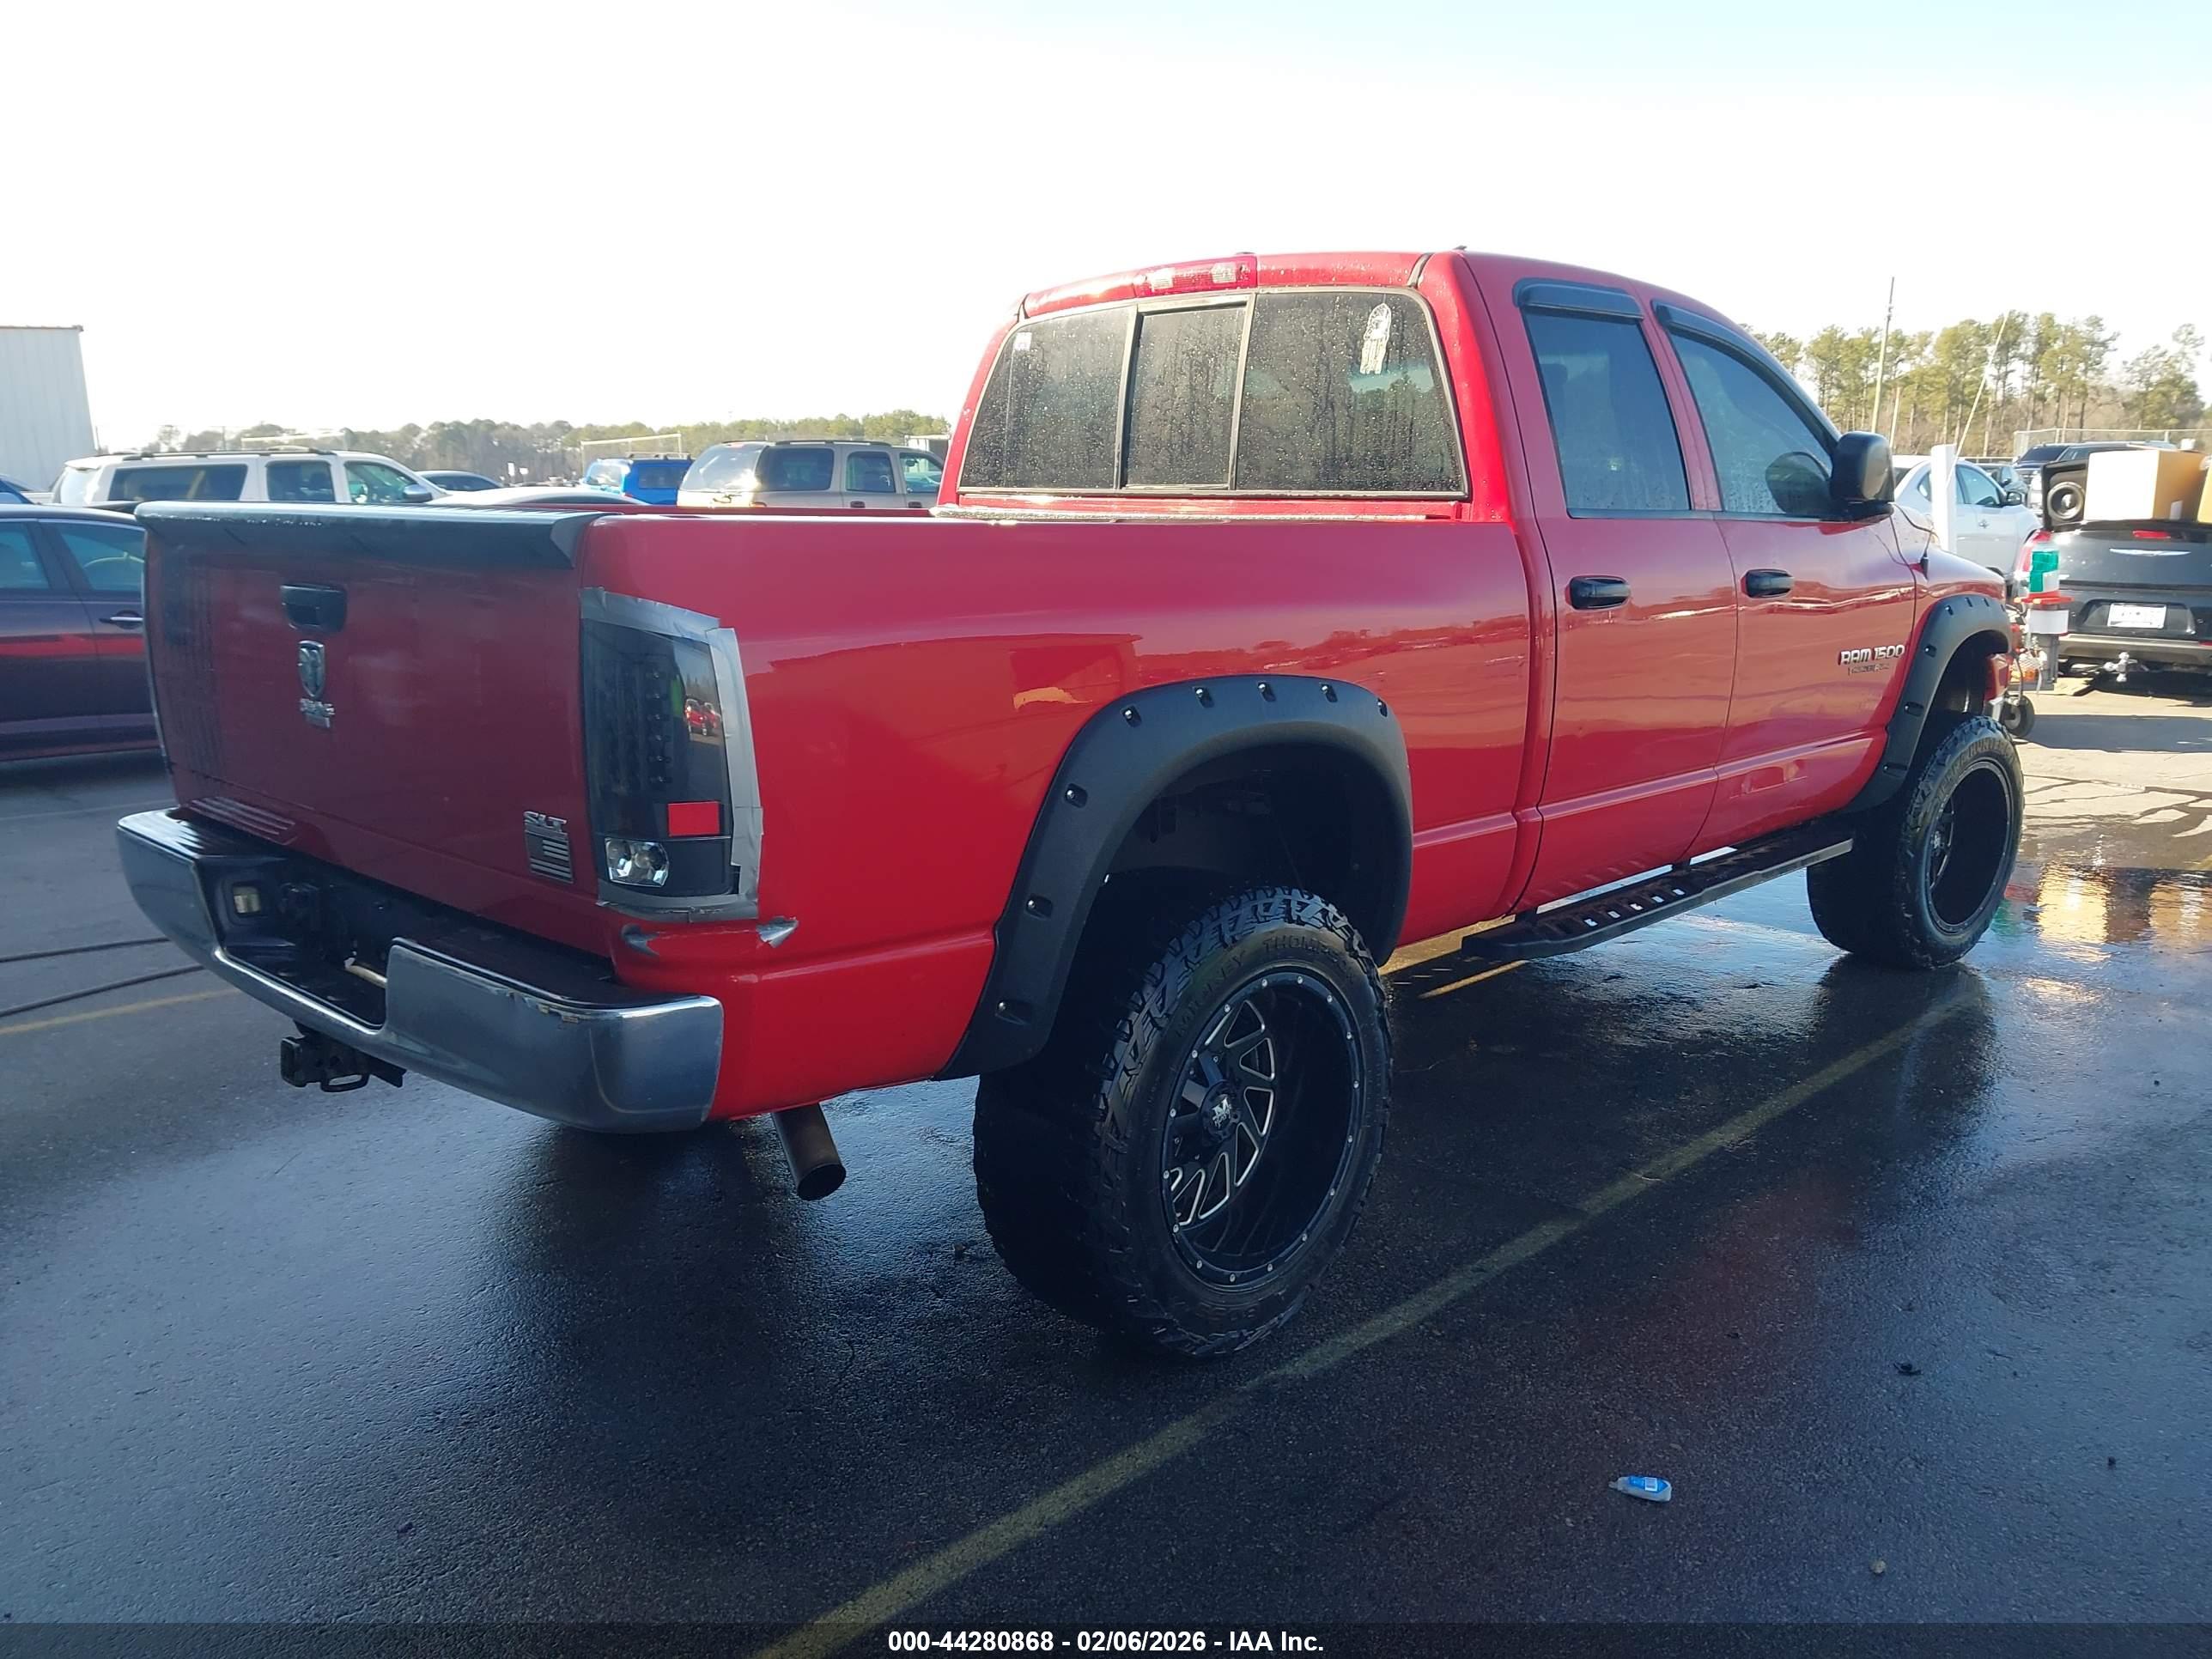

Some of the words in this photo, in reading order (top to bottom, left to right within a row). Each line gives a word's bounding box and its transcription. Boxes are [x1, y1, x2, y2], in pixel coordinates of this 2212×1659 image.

[1839, 648, 1872, 665] RAM
[1874, 644, 1905, 659] 1500
[524, 811, 568, 833] SLT
